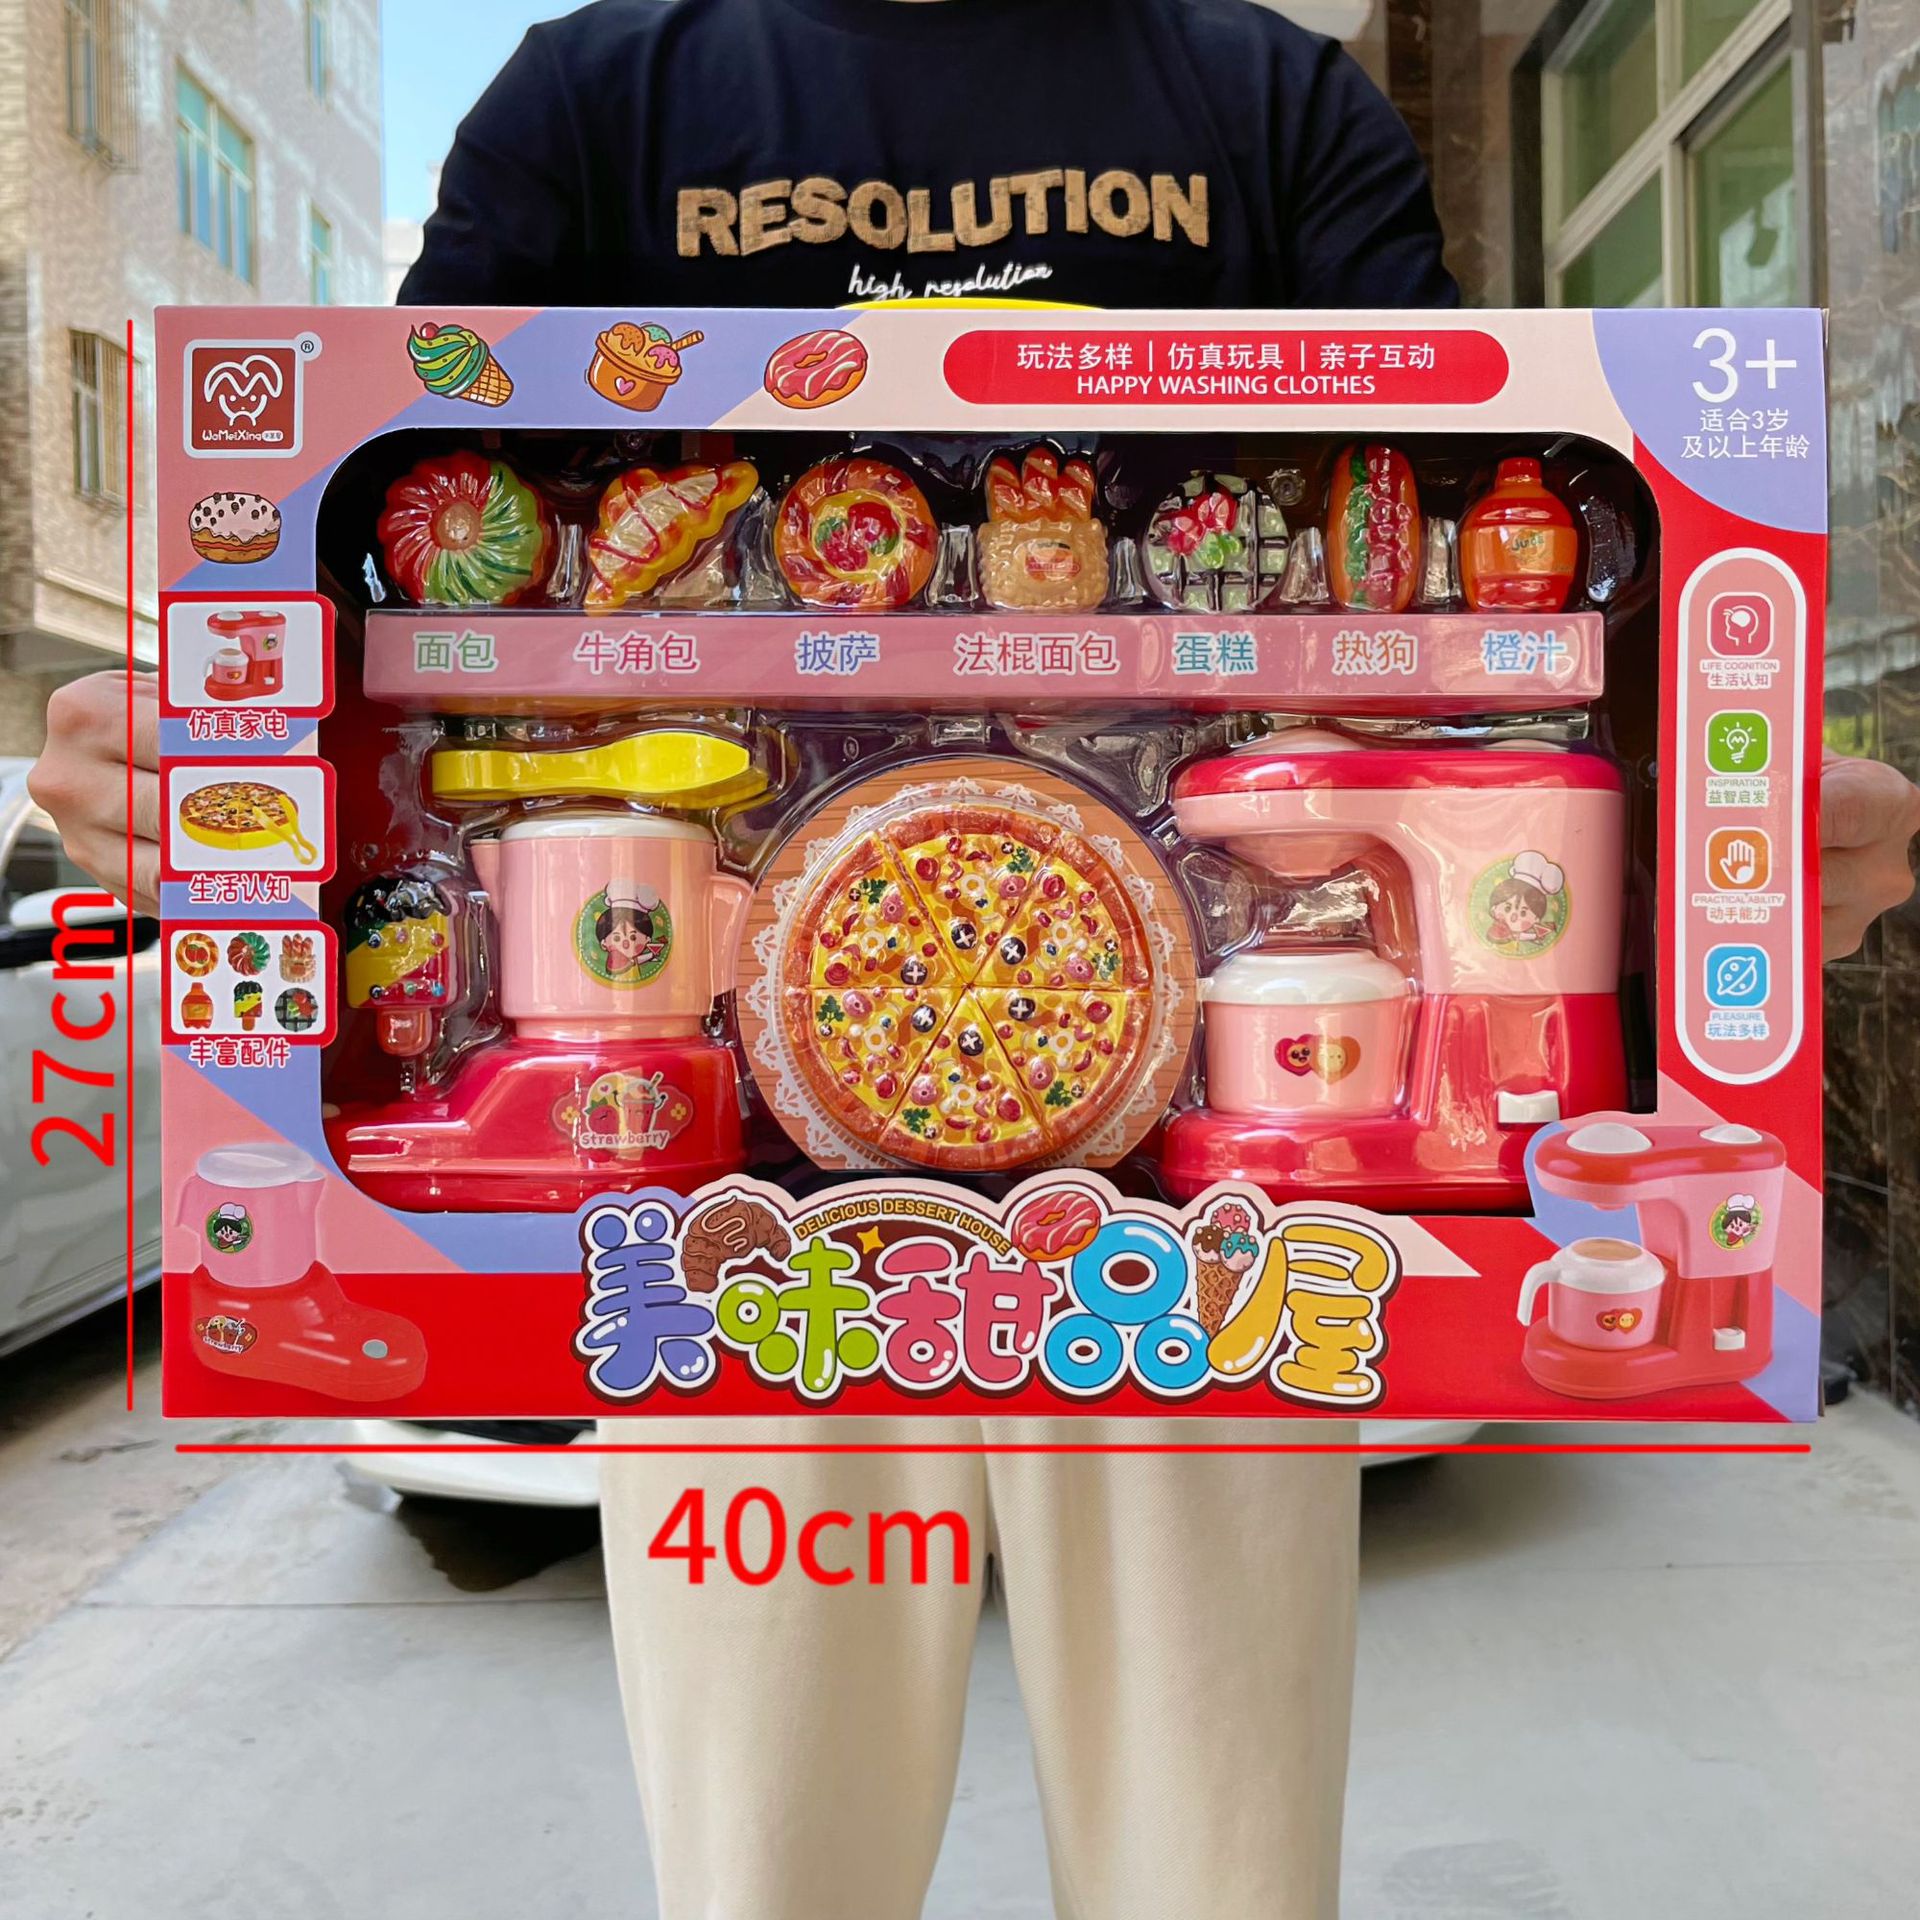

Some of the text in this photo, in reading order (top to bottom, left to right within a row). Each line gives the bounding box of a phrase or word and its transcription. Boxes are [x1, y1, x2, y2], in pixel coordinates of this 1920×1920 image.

[676, 167, 1209, 257] RESOLUTION
[848, 261, 1053, 301] high resolution
[1017, 343, 1436, 370] 玩法多样 仿真玩具 亲子互动
[1692, 327, 1797, 403] 3+
[1077, 376, 1375, 395] HAPPY WASHING CLOTHES
[1700, 408, 1789, 432] 适合3岁
[1680, 434, 1810, 459] 及以上年龄
[415, 632, 496, 672] 面包
[576, 632, 698, 673] 牛角包
[797, 632, 879, 673] 披萨
[955, 633, 1119, 674] 法棍面包
[1173, 633, 1256, 674] 蛋糕
[1334, 633, 1416, 673] 热狗
[1483, 632, 1566, 673] 橙汁
[1702, 661, 1777, 670] LIFE COGNITION
[1709, 673, 1769, 688] 生活认知
[189, 711, 288, 739] 仿真家电
[1708, 778, 1766, 787] INSPIRATION
[1708, 789, 1766, 804] 益智启发
[190, 875, 290, 903] 生活认知
[1694, 895, 1783, 904] PRACTICAL ABILITY
[1709, 906, 1767, 921] 动手能力
[1708, 1023, 1766, 1037] 玩法多样
[1712, 1012, 1761, 1021] PLEASURE
[190, 1039, 290, 1066] 丰富配件
[794, 1200, 1011, 1256] DELICIOUS DESSERT HOUSE
[580, 1201, 1392, 1396] 美味甜品屋
